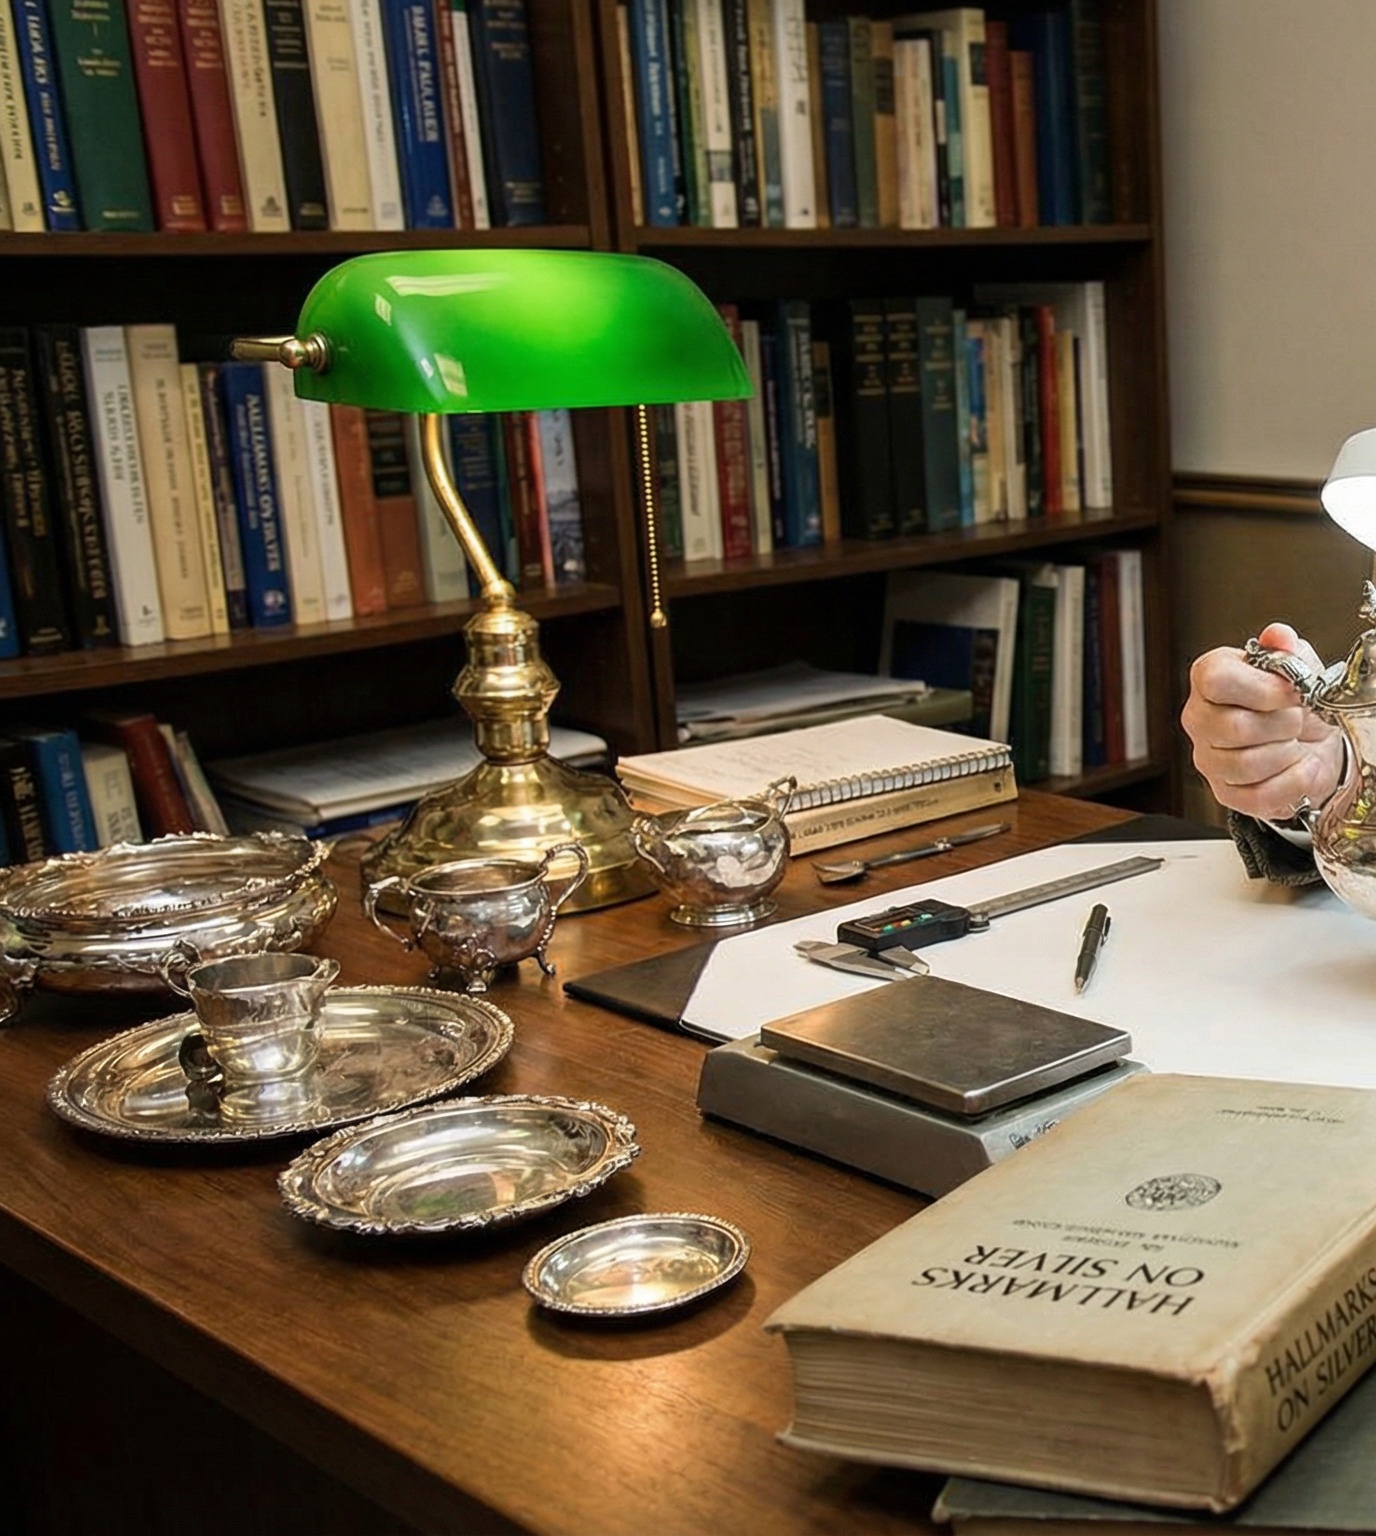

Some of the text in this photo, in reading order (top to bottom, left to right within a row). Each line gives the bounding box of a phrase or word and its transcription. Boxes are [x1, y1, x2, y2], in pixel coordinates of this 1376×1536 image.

[963, 1244, 1205, 1288] ON SILVER
[911, 1267, 1195, 1315] HALLMARKS
[1276, 1378, 1310, 1432] ON
